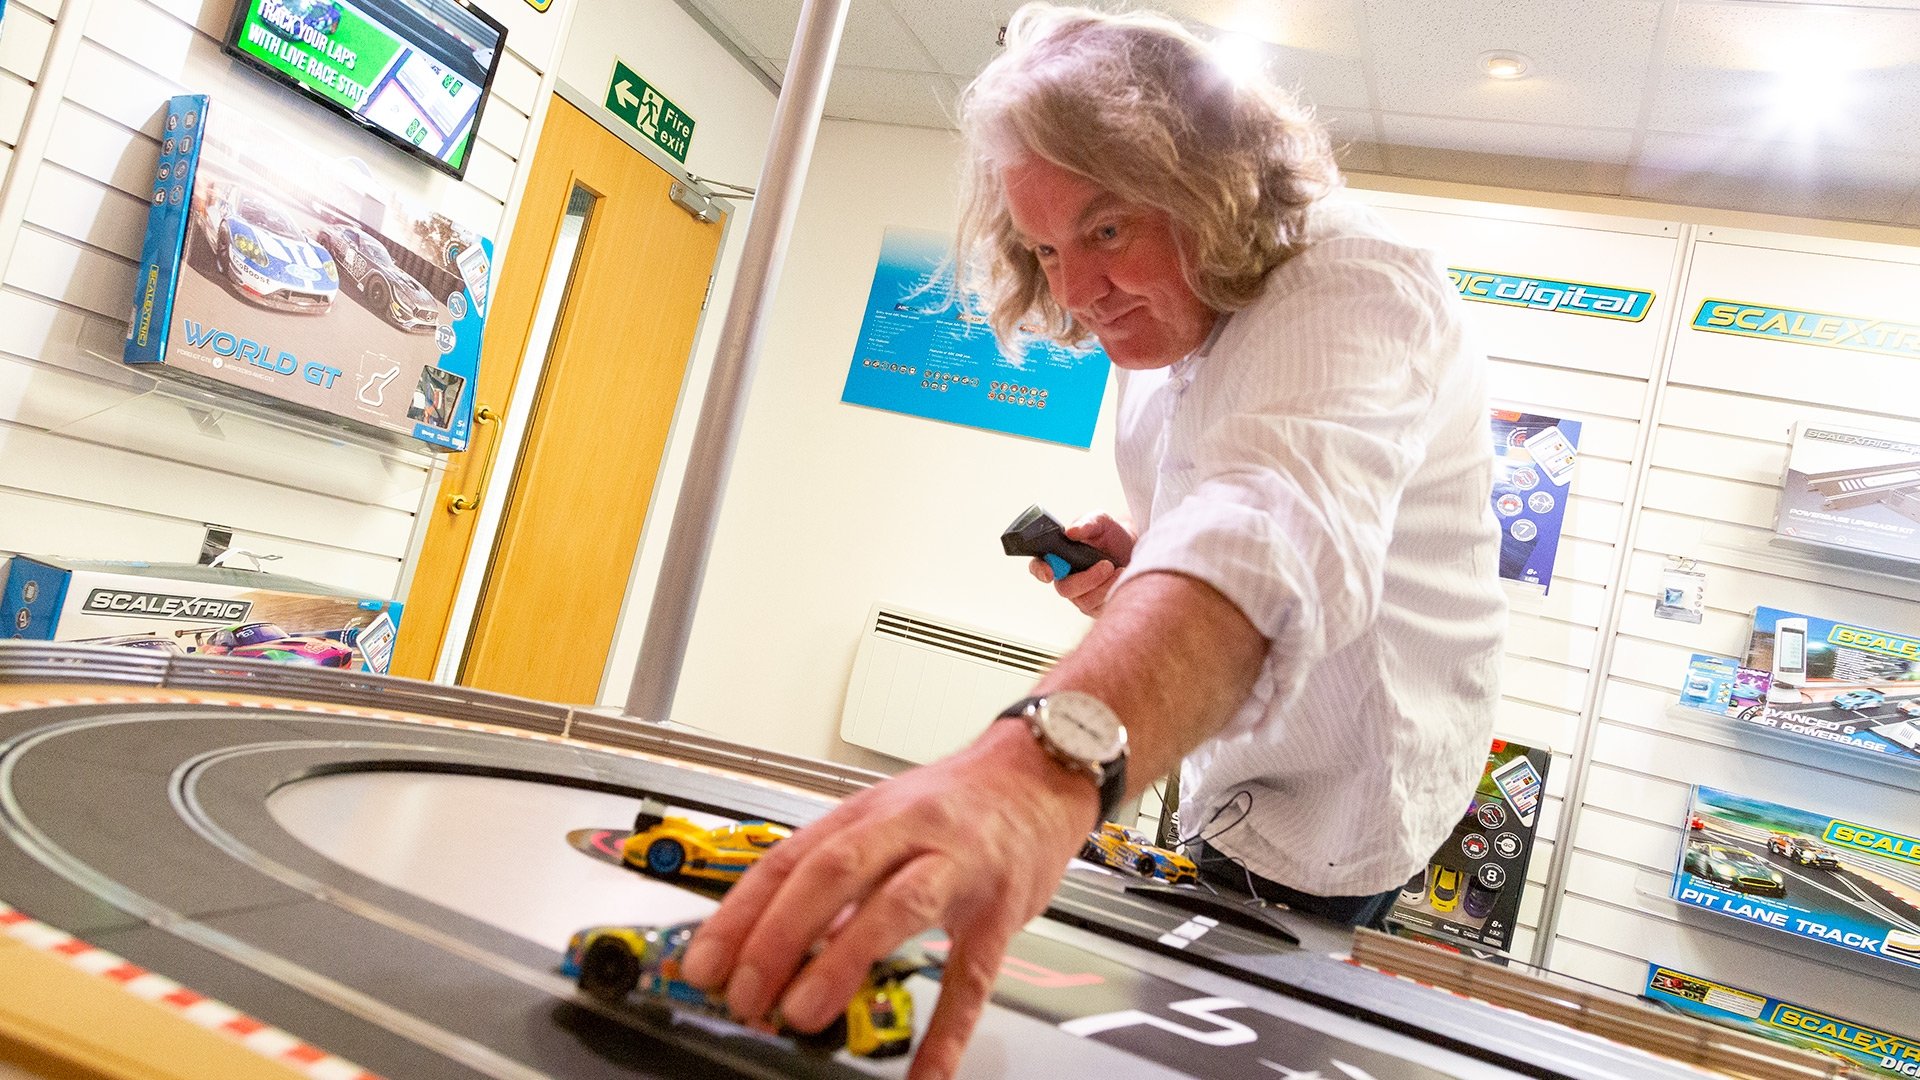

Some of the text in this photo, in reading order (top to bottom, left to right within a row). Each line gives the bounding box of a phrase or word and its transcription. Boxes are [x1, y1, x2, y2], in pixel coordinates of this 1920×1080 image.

[257, 0, 357, 71] TRACK YOUR LAPS
[248, 21, 282, 56] WITH
[280, 41, 309, 71] LIVE
[307, 56, 338, 89] RACE
[664, 108, 690, 138] Fire
[660, 130, 685, 156] exit
[1495, 279, 1639, 314] digital
[183, 318, 343, 390] WORLD GT
[90, 592, 245, 619] SCALEXTRIC
[1781, 722, 1888, 753] POWERBASE
[1843, 725, 1857, 735] 6
[1486, 869, 1498, 882] 8
[1491, 920, 1503, 928] 8+
[1680, 888, 1720, 907] PIT
[1722, 900, 1790, 927] LANE
[1795, 918, 1881, 952] TRACK
